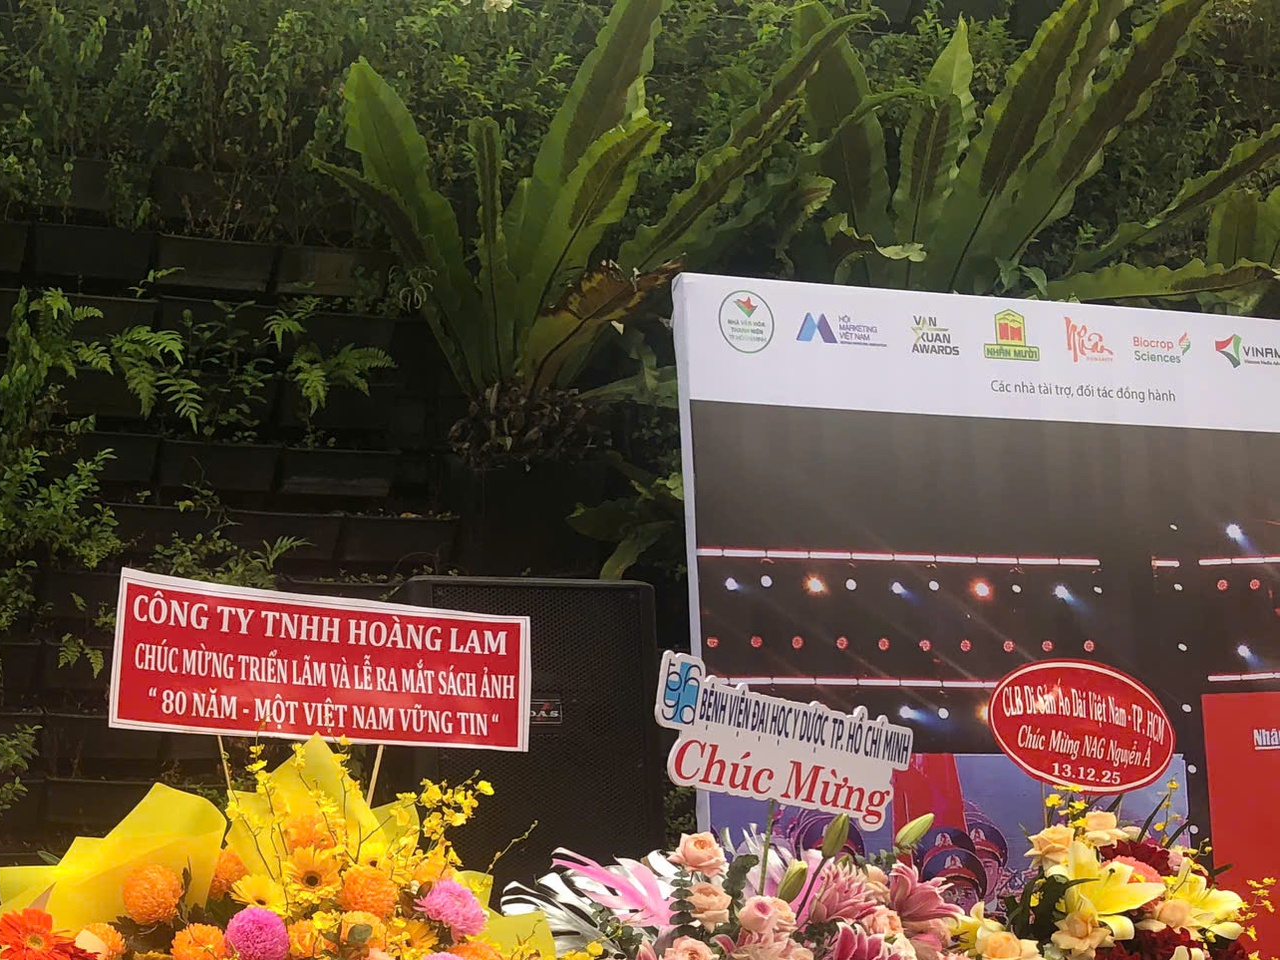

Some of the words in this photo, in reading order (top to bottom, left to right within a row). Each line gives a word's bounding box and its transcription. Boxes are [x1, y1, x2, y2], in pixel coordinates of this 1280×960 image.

[912, 343, 960, 356] AWARDS
[1133, 336, 1174, 352] Biocrop
[1134, 351, 1181, 364] Sciences
[990, 380, 1011, 393] Các
[1014, 381, 1035, 395] nhà
[1038, 382, 1052, 396] tài
[1055, 384, 1074, 399] trợ,
[1076, 384, 1094, 398] đối
[1097, 385, 1114, 399] tác
[1148, 389, 1176, 401] hành
[133, 590, 210, 630] CÔNG
[217, 606, 255, 635] TY
[261, 610, 341, 644] TNHH
[348, 616, 442, 652] HOÀNG
[449, 627, 507, 656] LAM
[134, 639, 179, 675] CHÚC
[182, 643, 234, 680] MỪNG
[238, 650, 288, 685] TRIỂN
[292, 654, 326, 687] LÃM
[330, 657, 351, 690] VÀ
[354, 654, 373, 691] LỄ
[376, 666, 398, 693] RA
[401, 659, 435, 695] MẮT
[438, 664, 477, 697] SÁCH
[480, 667, 515, 700] ẢNH
[161, 689, 186, 716] 80
[191, 688, 238, 720] NĂM
[254, 693, 299, 730] MỘT
[303, 697, 348, 734] VIỆT
[352, 705, 395, 731] NAM
[398, 704, 453, 735] VỮNG
[457, 711, 488, 736] TIN
[699, 683, 729, 731] BỆNH
[728, 690, 753, 737] VIỆN
[751, 700, 771, 741] ĐẠI
[769, 703, 793, 746] HỌC
[792, 708, 801, 739] Y
[799, 708, 828, 753] DƯỢC
[830, 717, 844, 751] TP.
[846, 713, 865, 754] HỒ
[864, 721, 884, 758] CHÍ
[882, 729, 911, 764] MINH
[1002, 685, 1024, 717] CLB
[1024, 685, 1037, 714] Di
[1058, 678, 1071, 717] Áo
[1071, 688, 1087, 718] Dài
[1088, 691, 1107, 728] Việt
[1108, 695, 1127, 727] Nam
[1147, 710, 1165, 745] HCM
[1017, 724, 1046, 750] Chúc
[1048, 729, 1080, 760] Mừng
[1081, 734, 1106, 759] NAG
[1142, 740, 1151, 768] Á
[674, 739, 774, 794] Chúc
[780, 760, 890, 824] Mừng
[1052, 762, 1121, 785] 13.12.25
